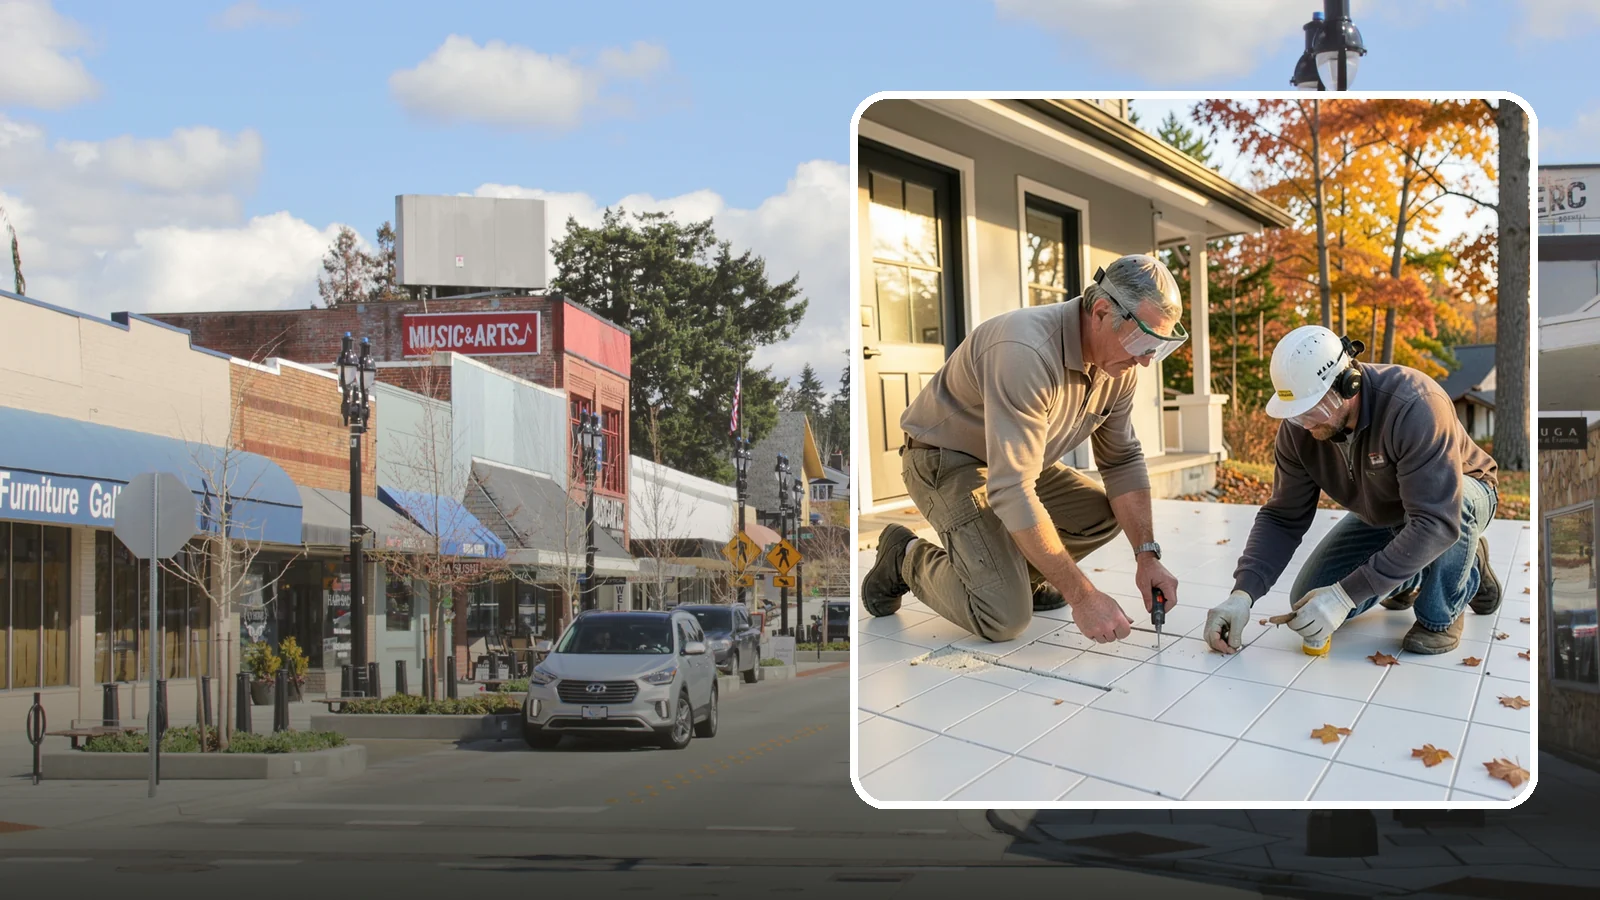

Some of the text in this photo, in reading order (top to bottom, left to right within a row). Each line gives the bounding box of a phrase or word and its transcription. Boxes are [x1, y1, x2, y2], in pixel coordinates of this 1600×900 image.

[408, 323, 520, 349] MUSIC&ARTS
[0, 471, 122, 519] Furniture Gal
